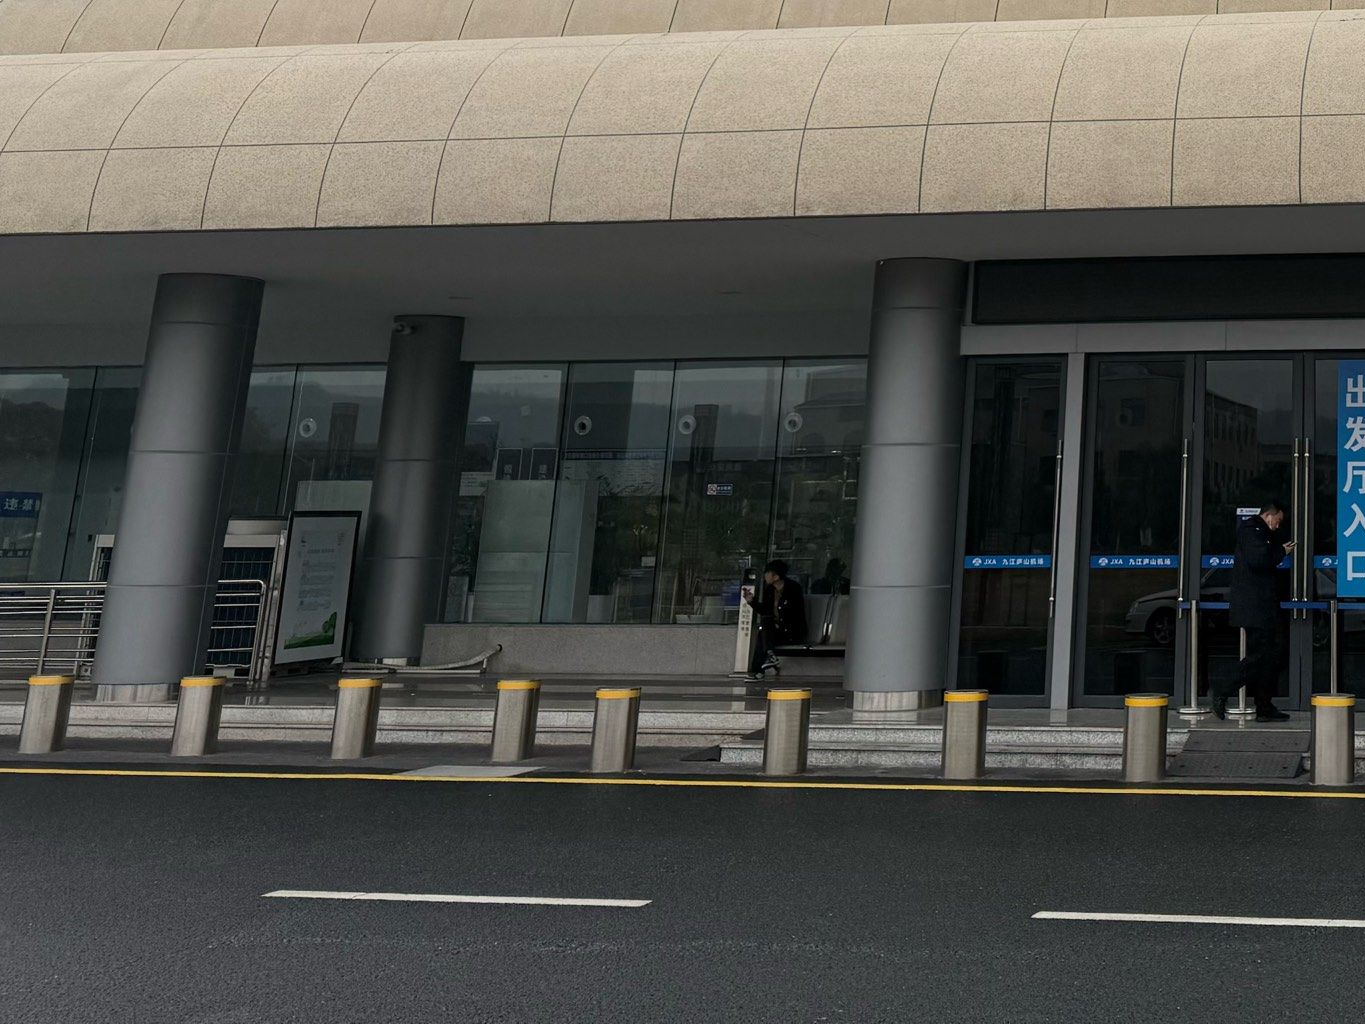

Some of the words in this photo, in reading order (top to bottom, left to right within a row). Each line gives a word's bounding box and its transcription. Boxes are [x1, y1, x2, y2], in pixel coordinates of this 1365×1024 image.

[1002, 558, 1044, 566] 九江庐山机场
[1128, 558, 1171, 566] 九江庐山机场
